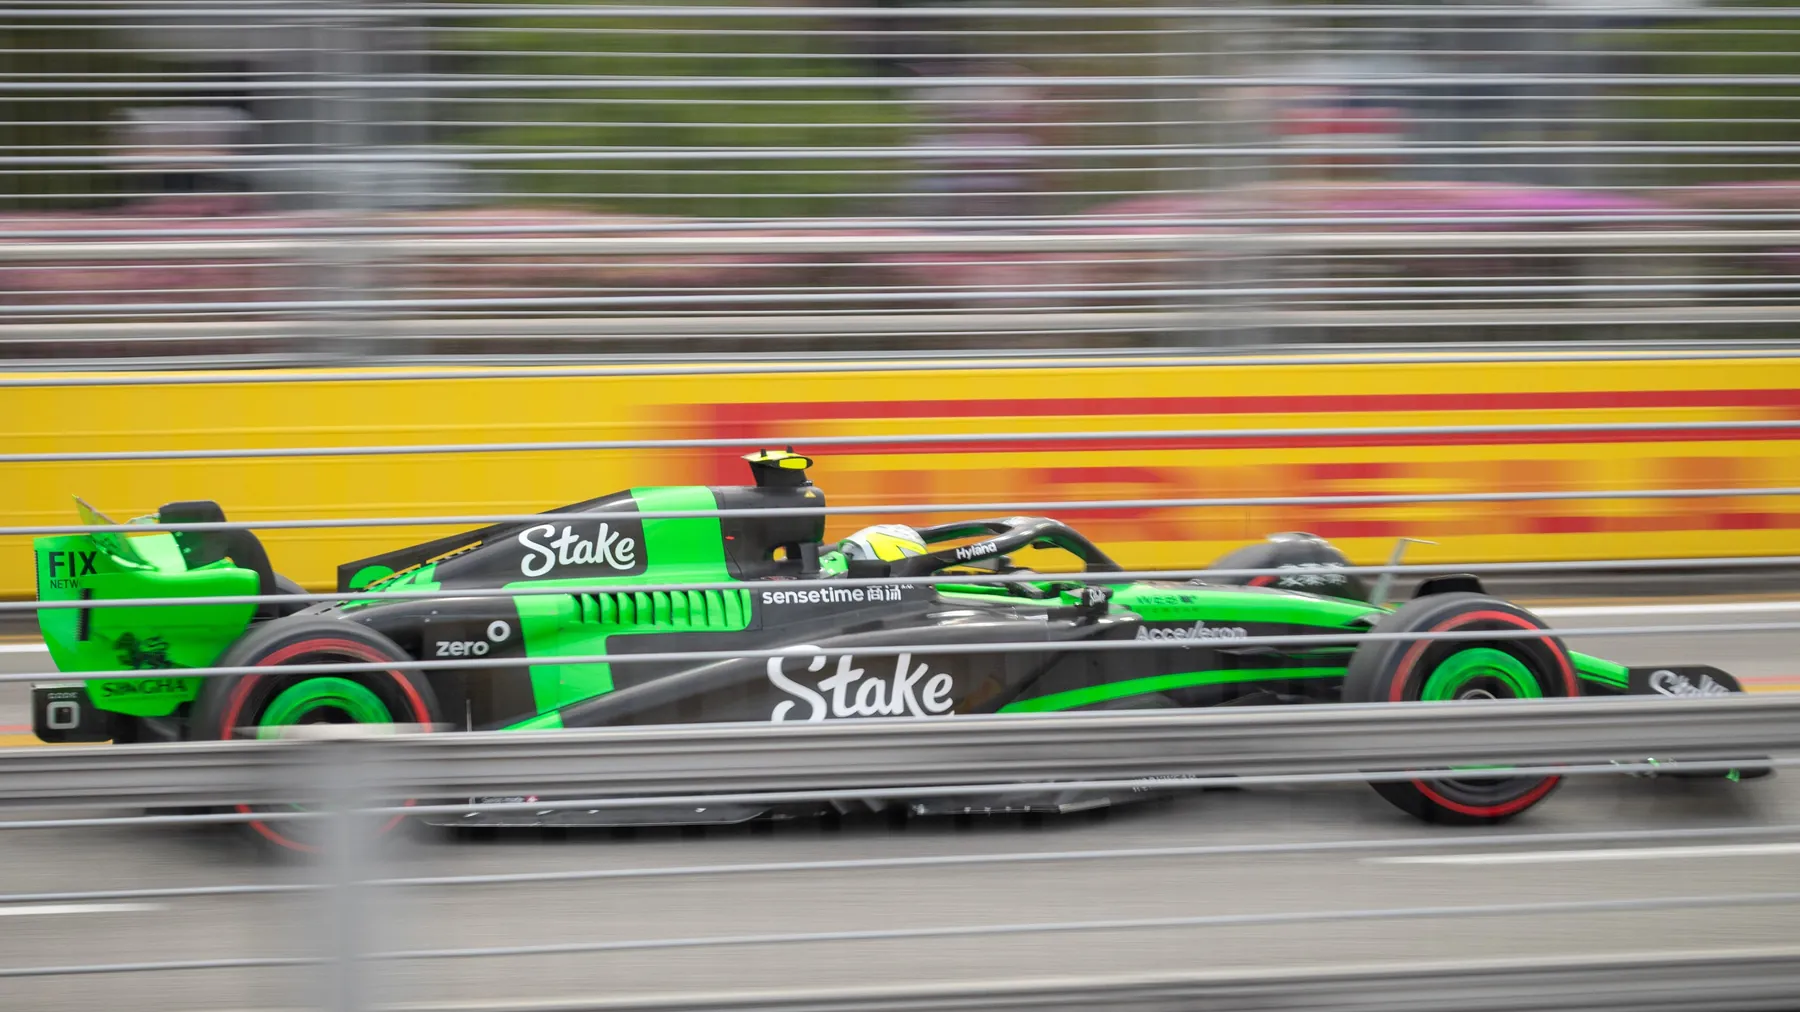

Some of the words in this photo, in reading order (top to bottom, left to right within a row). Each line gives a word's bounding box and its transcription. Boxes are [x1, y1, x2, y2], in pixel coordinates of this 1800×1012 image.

[518, 523, 636, 577] Stake
[956, 542, 998, 560] Hyland
[48, 551, 98, 578] FIX
[50, 579, 82, 589] NETW
[762, 586, 865, 605] sensetime
[766, 644, 956, 724] Stake
